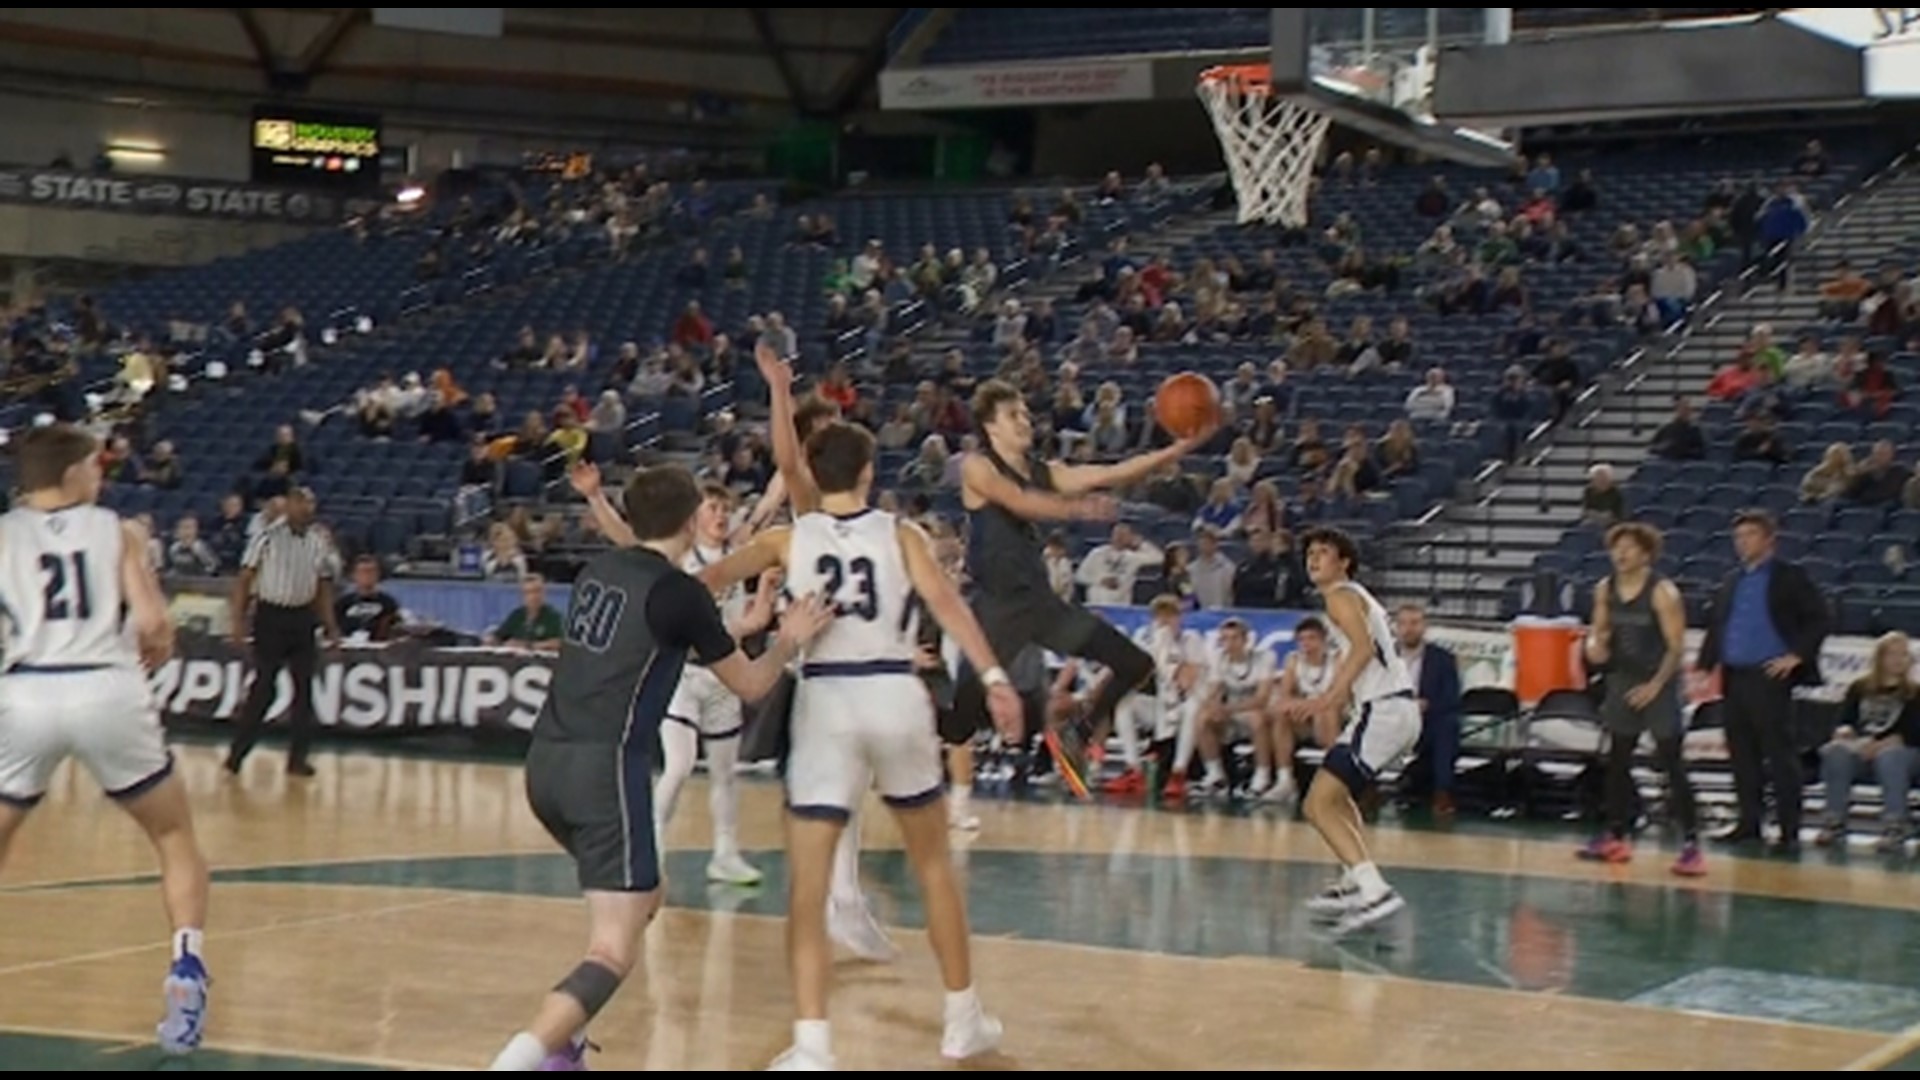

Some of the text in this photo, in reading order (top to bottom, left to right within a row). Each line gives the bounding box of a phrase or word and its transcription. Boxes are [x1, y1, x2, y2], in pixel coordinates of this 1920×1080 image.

[30, 174, 133, 204] STATE
[186, 186, 283, 214] STATE
[39, 551, 90, 620] 21
[564, 580, 628, 654] 20
[816, 553, 878, 622] 23
